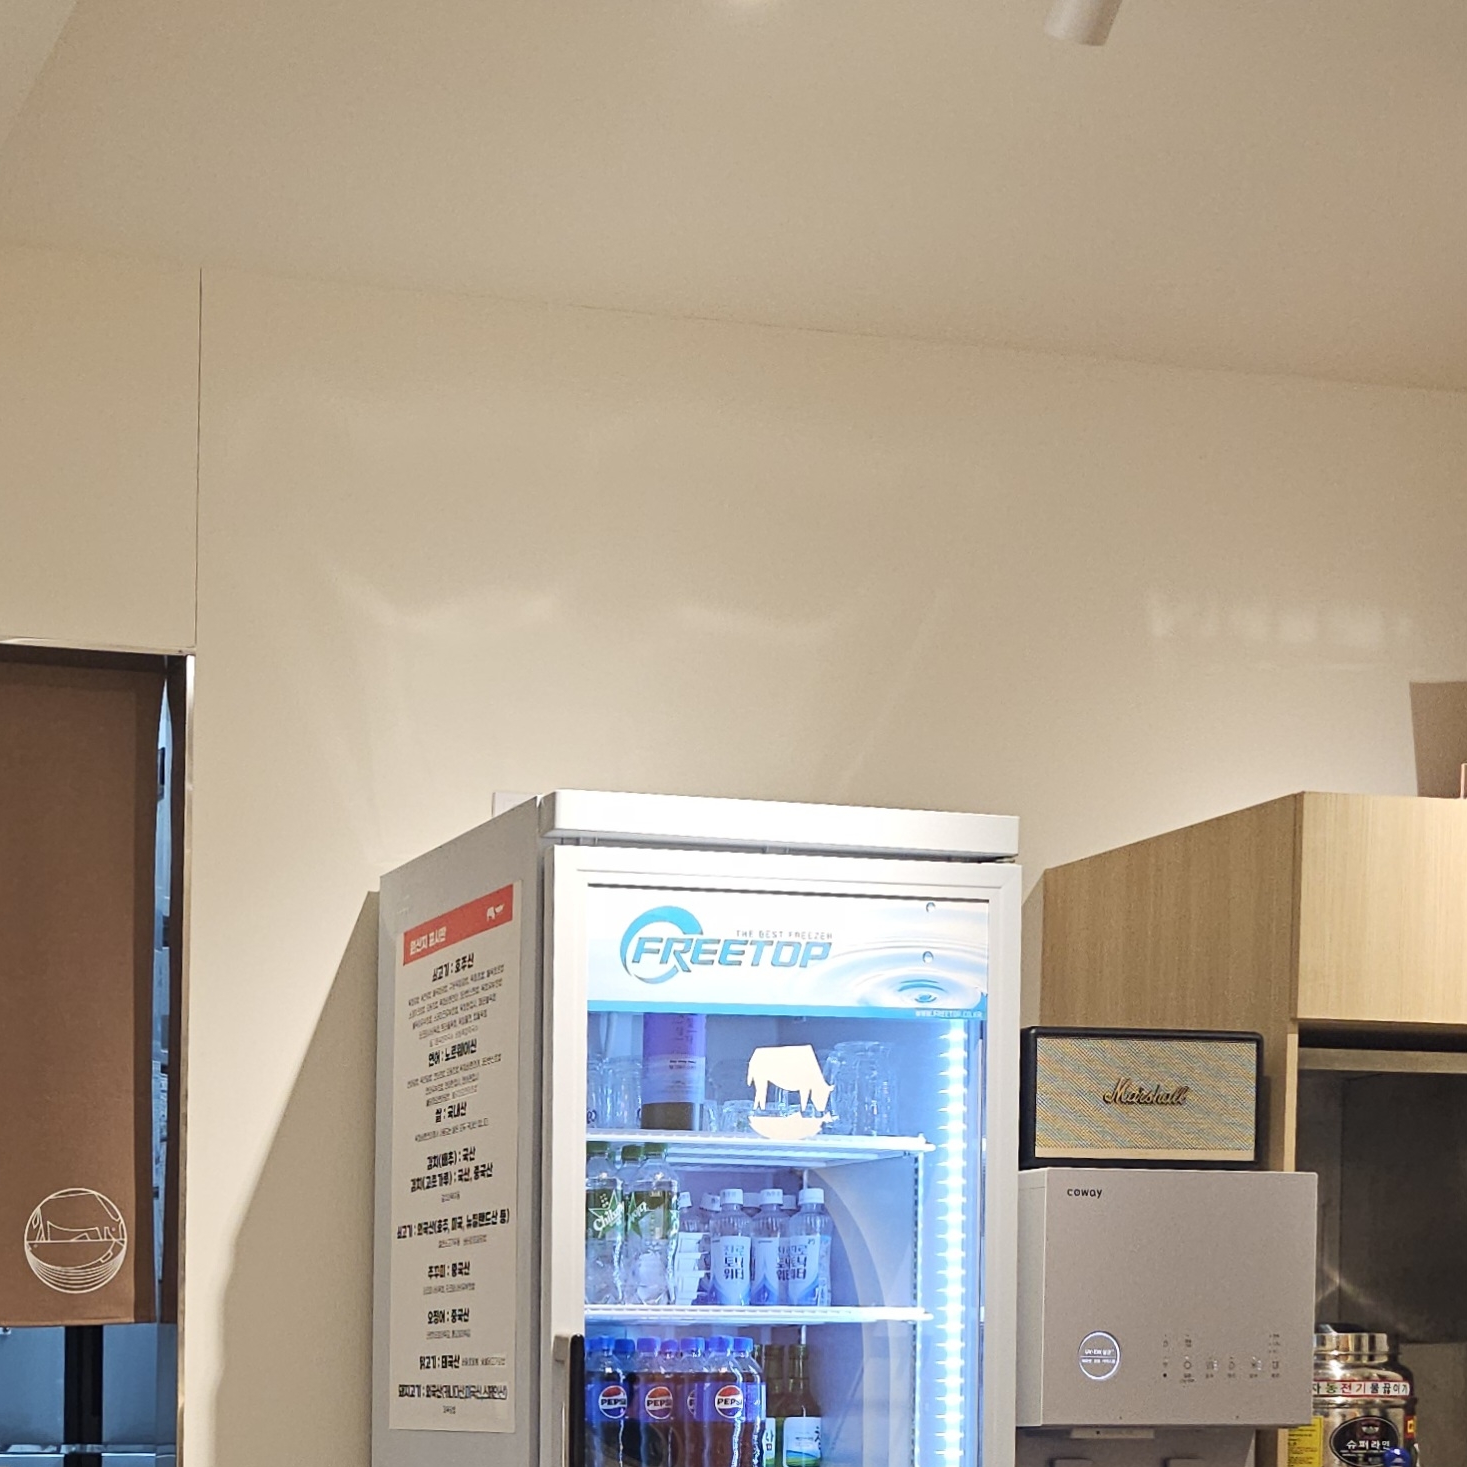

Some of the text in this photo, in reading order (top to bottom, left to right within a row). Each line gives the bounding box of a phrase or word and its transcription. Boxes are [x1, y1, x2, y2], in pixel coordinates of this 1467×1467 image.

[632, 936, 832, 973] FREETOP
[1102, 1077, 1190, 1106] Marshall
[1066, 1188, 1103, 1200] coway
